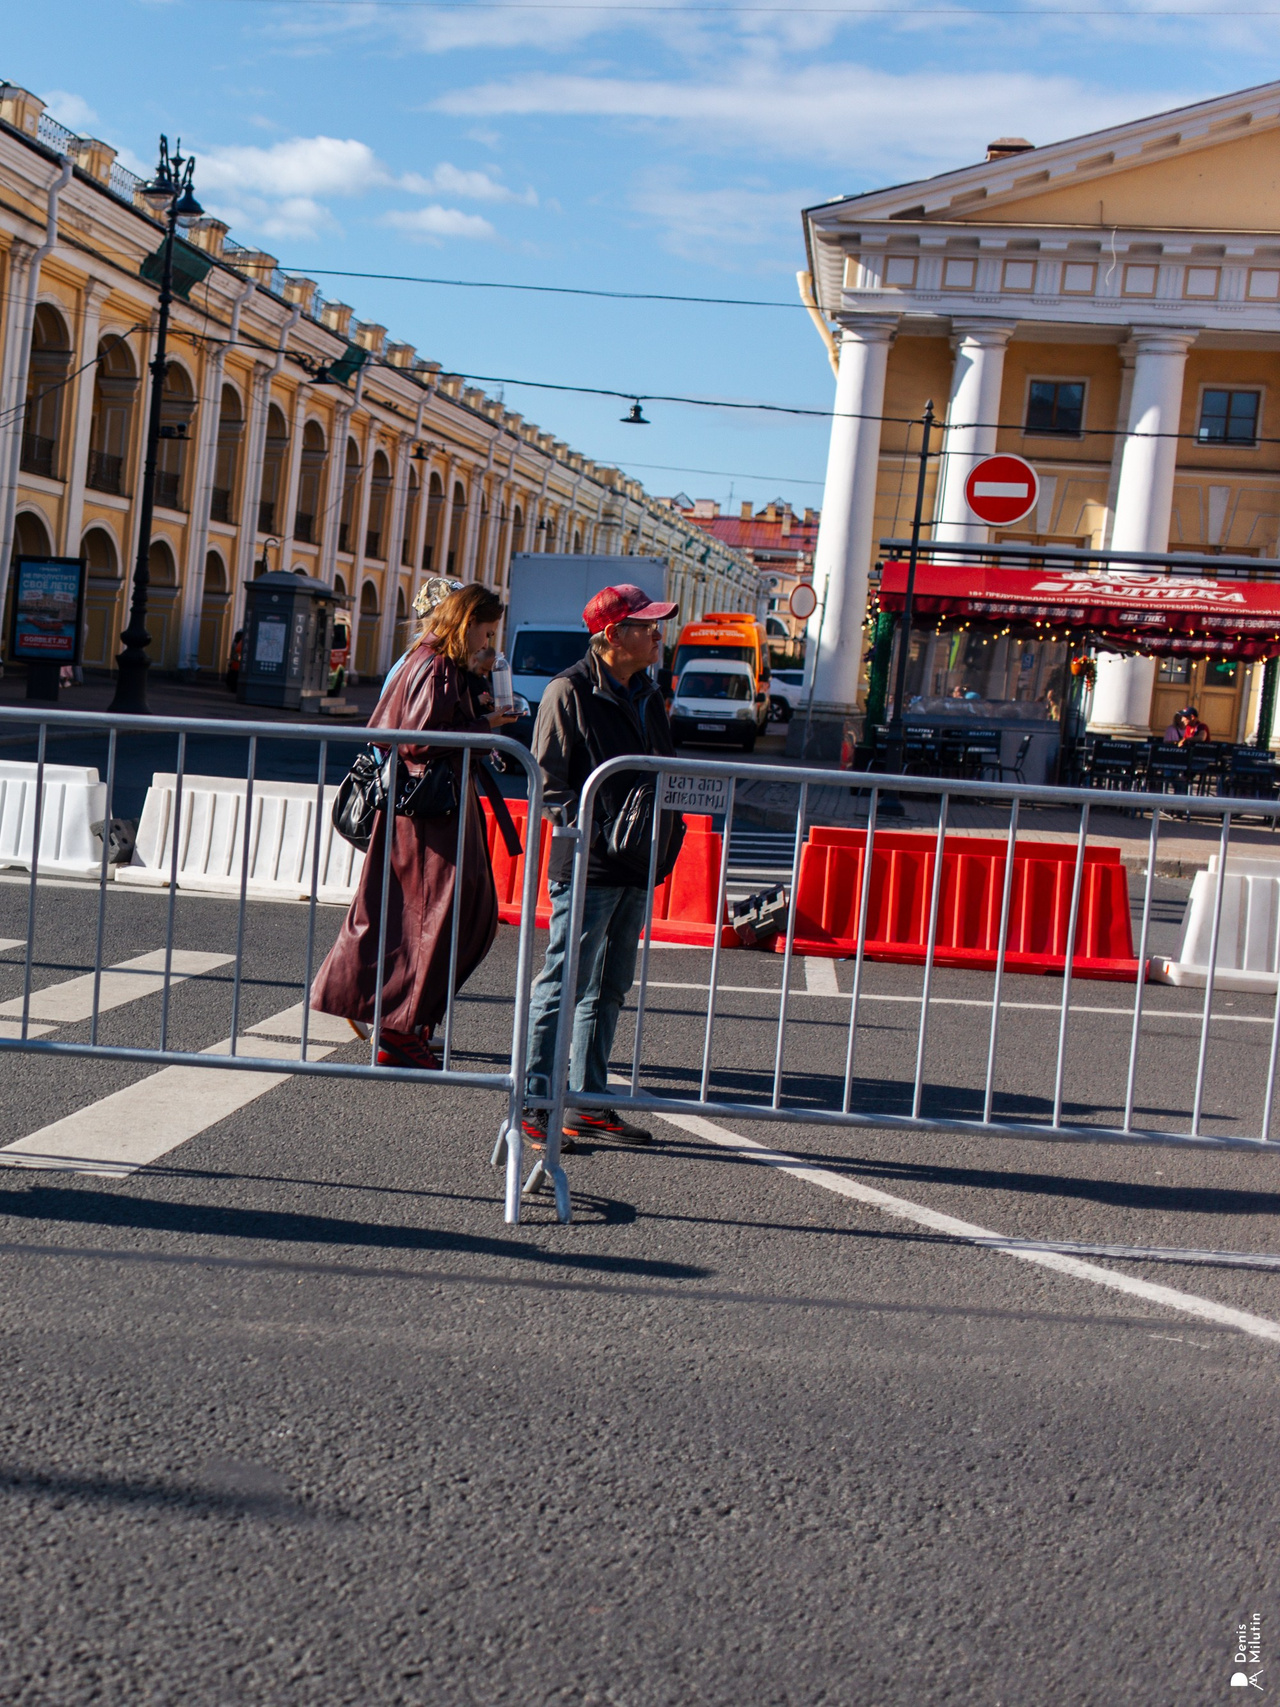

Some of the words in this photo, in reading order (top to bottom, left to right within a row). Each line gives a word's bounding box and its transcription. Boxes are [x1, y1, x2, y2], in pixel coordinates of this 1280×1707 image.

[50, 582, 76, 590] ЛЕТО
[1067, 582, 1247, 603] БАЛТИКА
[985, 591, 1056, 602] ПРЕДУПРЕЖДАЕМ
[1091, 599, 1150, 608] ЧРЕЗМЕРНОГО
[1151, 602, 1209, 610] ПОТРЕБЛЕНИЯ
[1210, 606, 1272, 615] АЛКОГОЛЬНОЙ
[292, 614, 304, 675] TOILET
